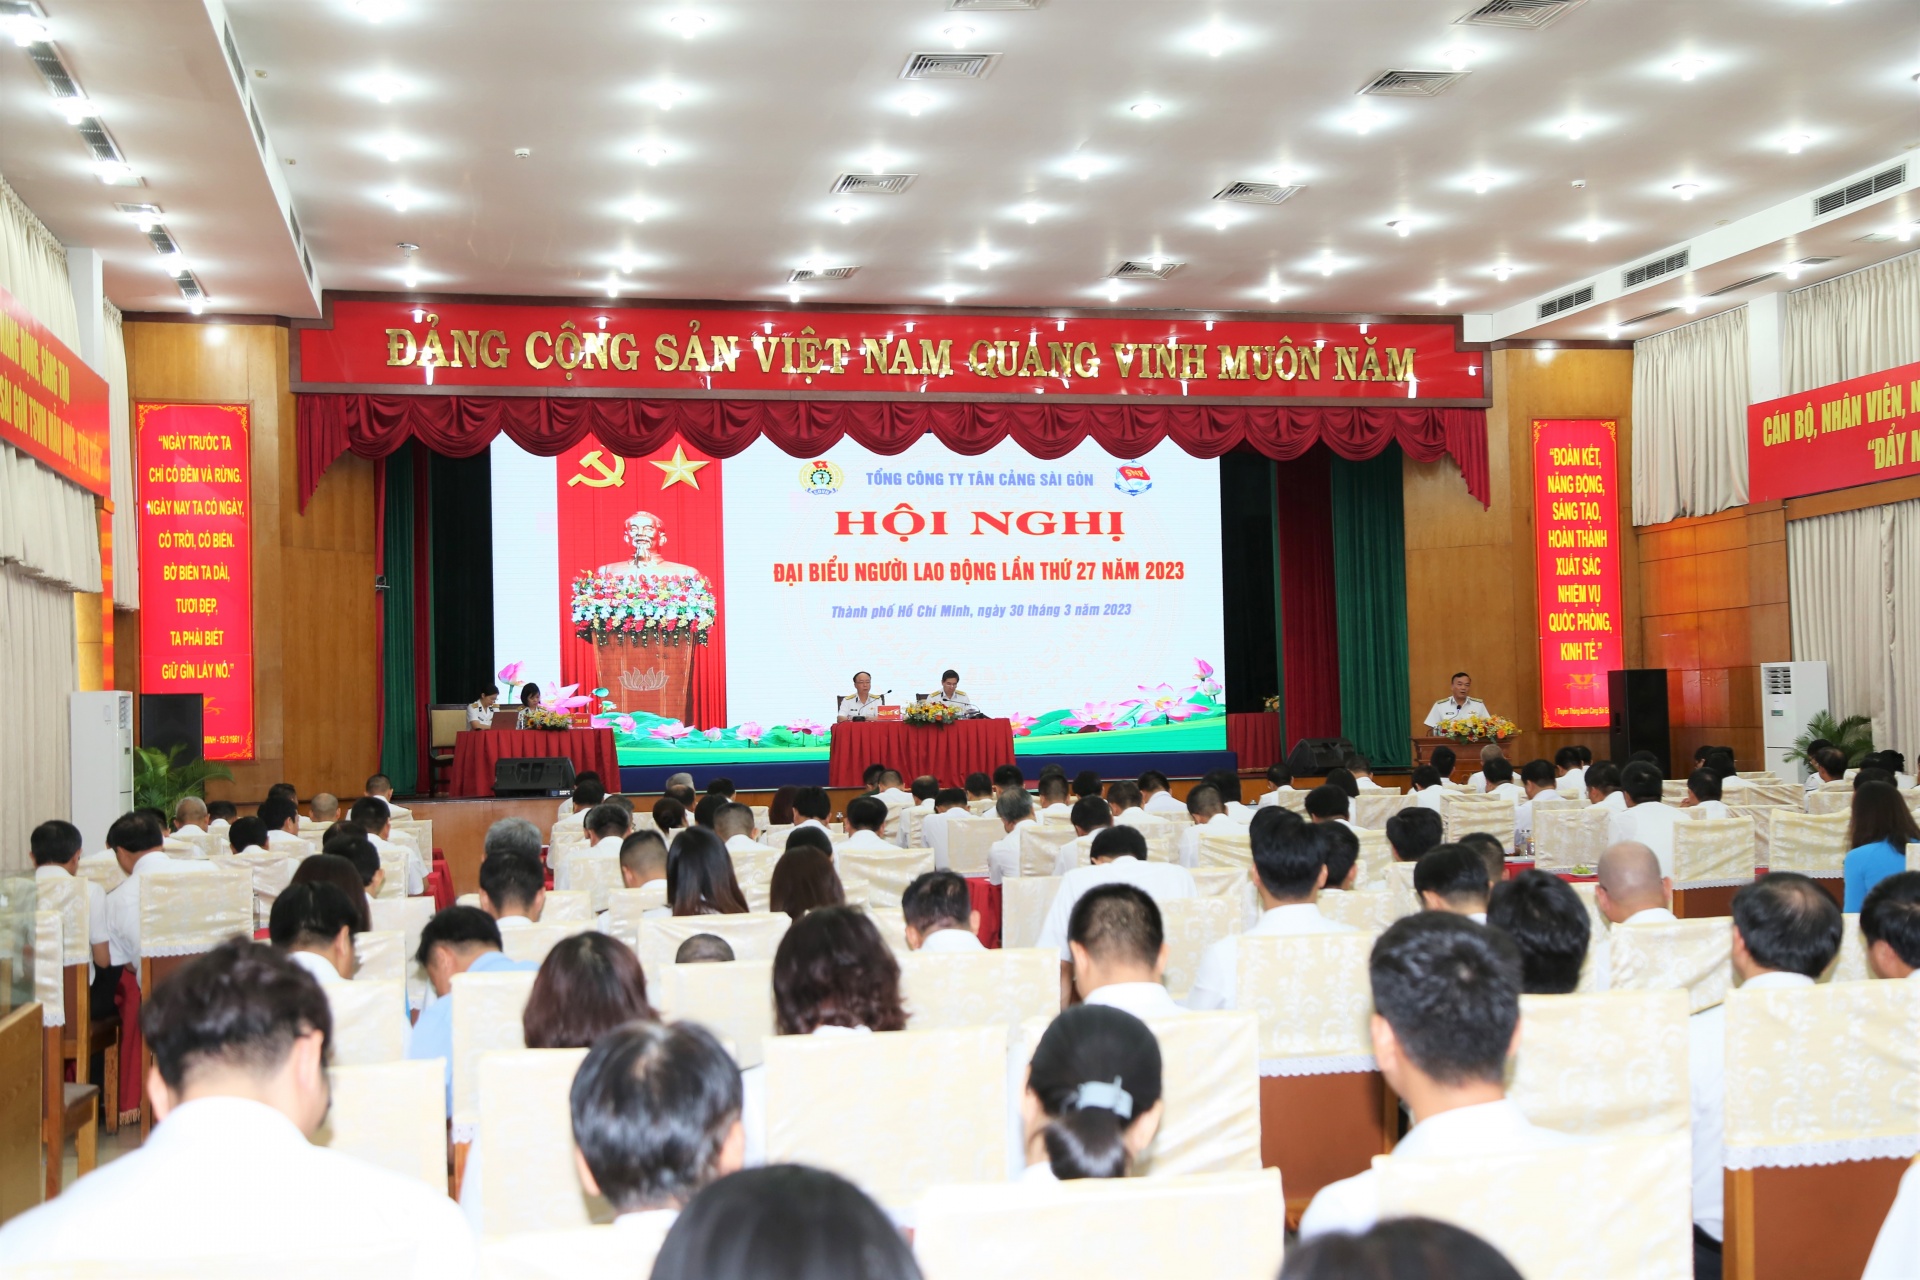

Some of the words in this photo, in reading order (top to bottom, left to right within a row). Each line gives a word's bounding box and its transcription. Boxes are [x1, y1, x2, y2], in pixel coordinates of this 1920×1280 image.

[385, 313, 510, 370] ĐẢNG
[525, 320, 640, 381] CỘNG
[655, 320, 739, 373] SẢN
[751, 326, 851, 384] VIỆT
[863, 338, 954, 377] NAM
[968, 338, 1100, 379] QUANG
[1112, 341, 1208, 379] VINH
[1217, 335, 1324, 381] MUÔN
[1334, 335, 1417, 383] NĂM
[1763, 410, 1790, 447] CÁN
[1794, 402, 1818, 443] BỘ,
[1821, 392, 1862, 434] NHÂN
[1865, 381, 1906, 424] VIÊN,
[188, 432, 219, 450] TRƯỚC
[221, 436, 232, 450] TA
[165, 464, 179, 482] CÓ
[180, 464, 199, 482] ĐÊM
[200, 464, 213, 482] VÀ
[866, 468, 902, 486] TỔNG
[906, 470, 944, 486] CÔNG
[948, 472, 964, 486] TY
[968, 470, 994, 486] TÂN
[999, 469, 1036, 486] CẢNG
[1040, 469, 1062, 486] SÀI
[1066, 470, 1094, 486] GÒN
[1547, 471, 1574, 493] NĂNG
[147, 497, 171, 515] NGÀY
[173, 500, 190, 515] NAY
[192, 500, 203, 515] TA
[204, 497, 217, 515] CÓ
[1552, 498, 1578, 520] SÁNG
[833, 503, 949, 542] HỘI
[970, 510, 1126, 542] NGHỊ
[158, 529, 171, 548] CÓ
[198, 529, 211, 548] CÓ
[1548, 525, 1575, 548] HOÀN
[1576, 525, 1607, 548] THÀNH
[164, 562, 177, 580] BỜ
[201, 565, 212, 580] TA
[773, 563, 803, 586] ĐẠI
[809, 555, 849, 582] BIỂU
[855, 558, 908, 582] NGƯỜI
[913, 562, 945, 581] LAO
[950, 558, 996, 585] ĐỘNG
[1002, 556, 1034, 580] LẦN
[1040, 558, 1073, 580] THỨ
[1076, 562, 1096, 580] 27
[1102, 558, 1140, 580] NĂM
[1145, 562, 1184, 580] 2023
[1558, 582, 1587, 607] NHIỆM
[1588, 585, 1601, 607] VỤ
[176, 598, 197, 613] TƯƠI
[831, 605, 868, 618] Thành
[871, 604, 896, 619] phố
[917, 604, 937, 618] Chí
[940, 604, 974, 618] Minh,
[977, 604, 1006, 618] ngày
[1010, 604, 1024, 616] 30
[1027, 604, 1060, 618] tháng
[1064, 604, 1071, 616] 3
[1075, 603, 1100, 616] năm
[1103, 603, 1132, 616] 2023
[1549, 609, 1575, 632] QUỐC
[170, 631, 181, 646] TA
[1560, 642, 1583, 660] KINH
[180, 660, 195, 679] GÌN
